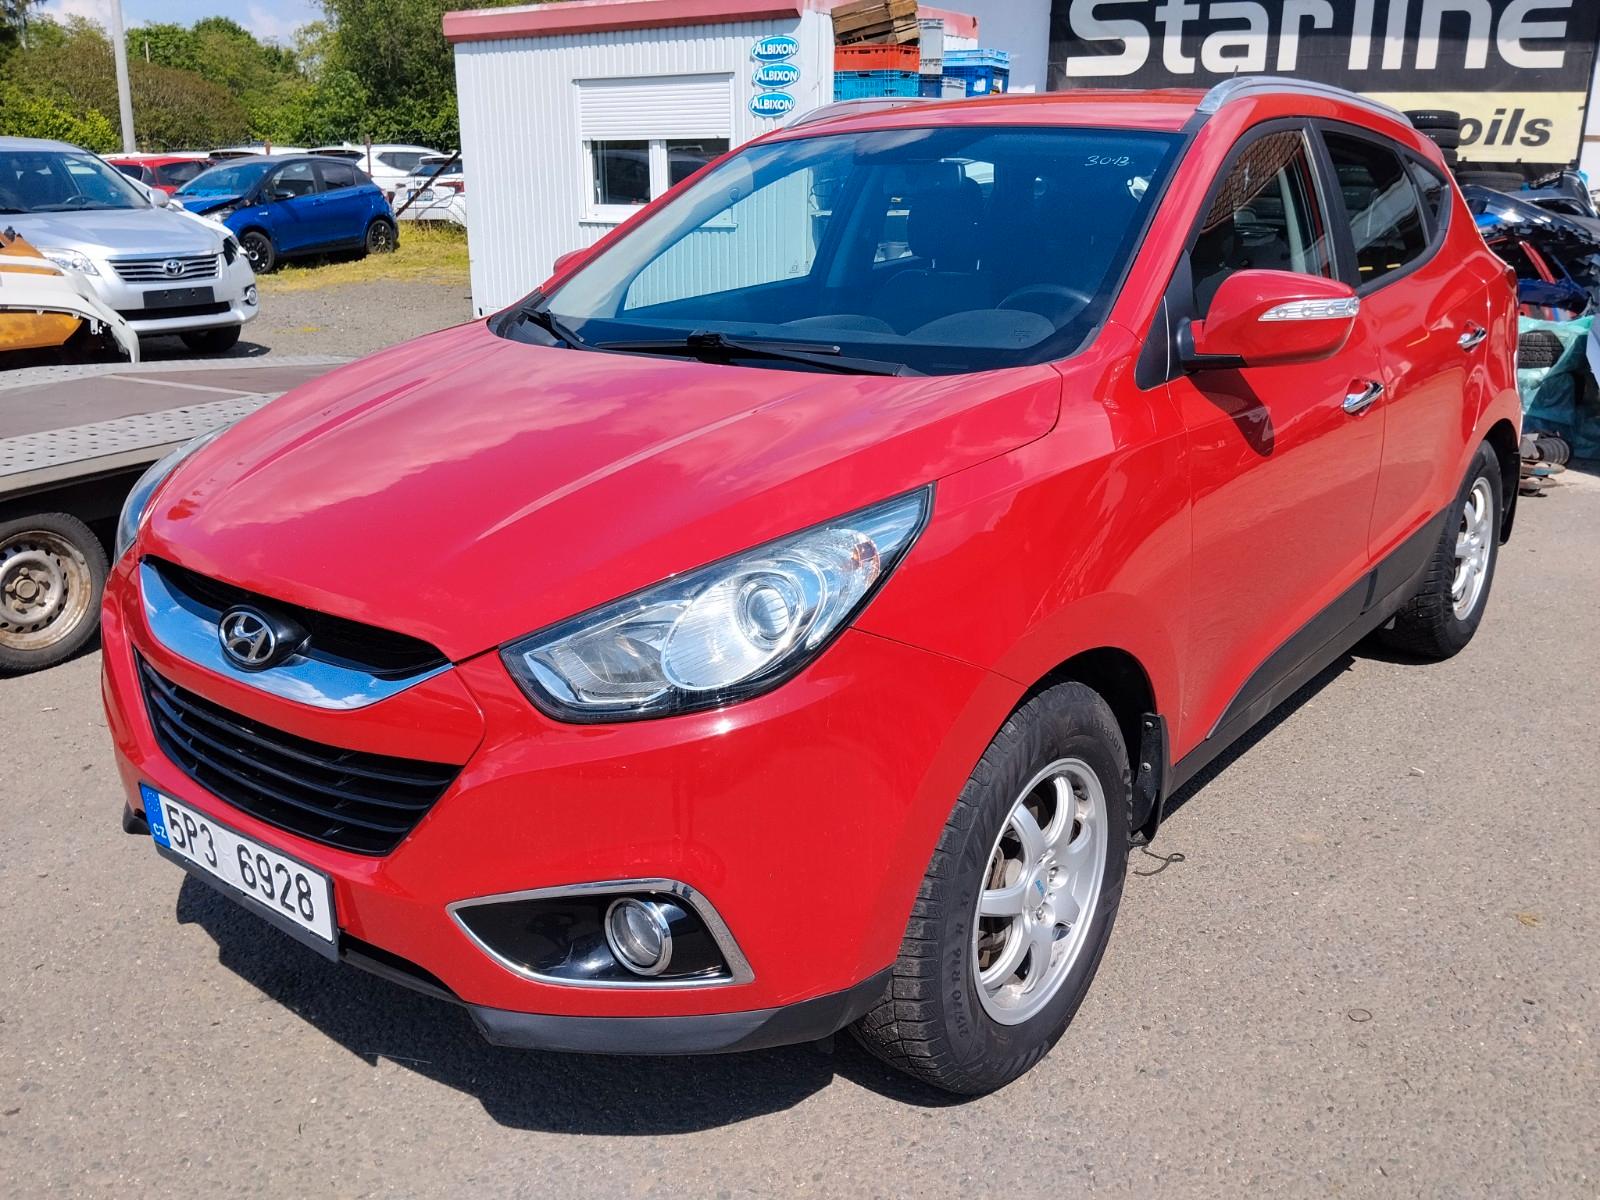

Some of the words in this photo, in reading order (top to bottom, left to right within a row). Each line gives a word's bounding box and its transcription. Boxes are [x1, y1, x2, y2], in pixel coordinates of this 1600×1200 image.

[754, 41, 796, 55] ALBIXON
[756, 67, 798, 81] ALBIXON
[751, 95, 792, 110] ALBIXON
[1458, 108, 1553, 147] oils
[153, 823, 167, 839] CZ
[165, 802, 218, 868] 5P3
[236, 843, 314, 922] 6928
